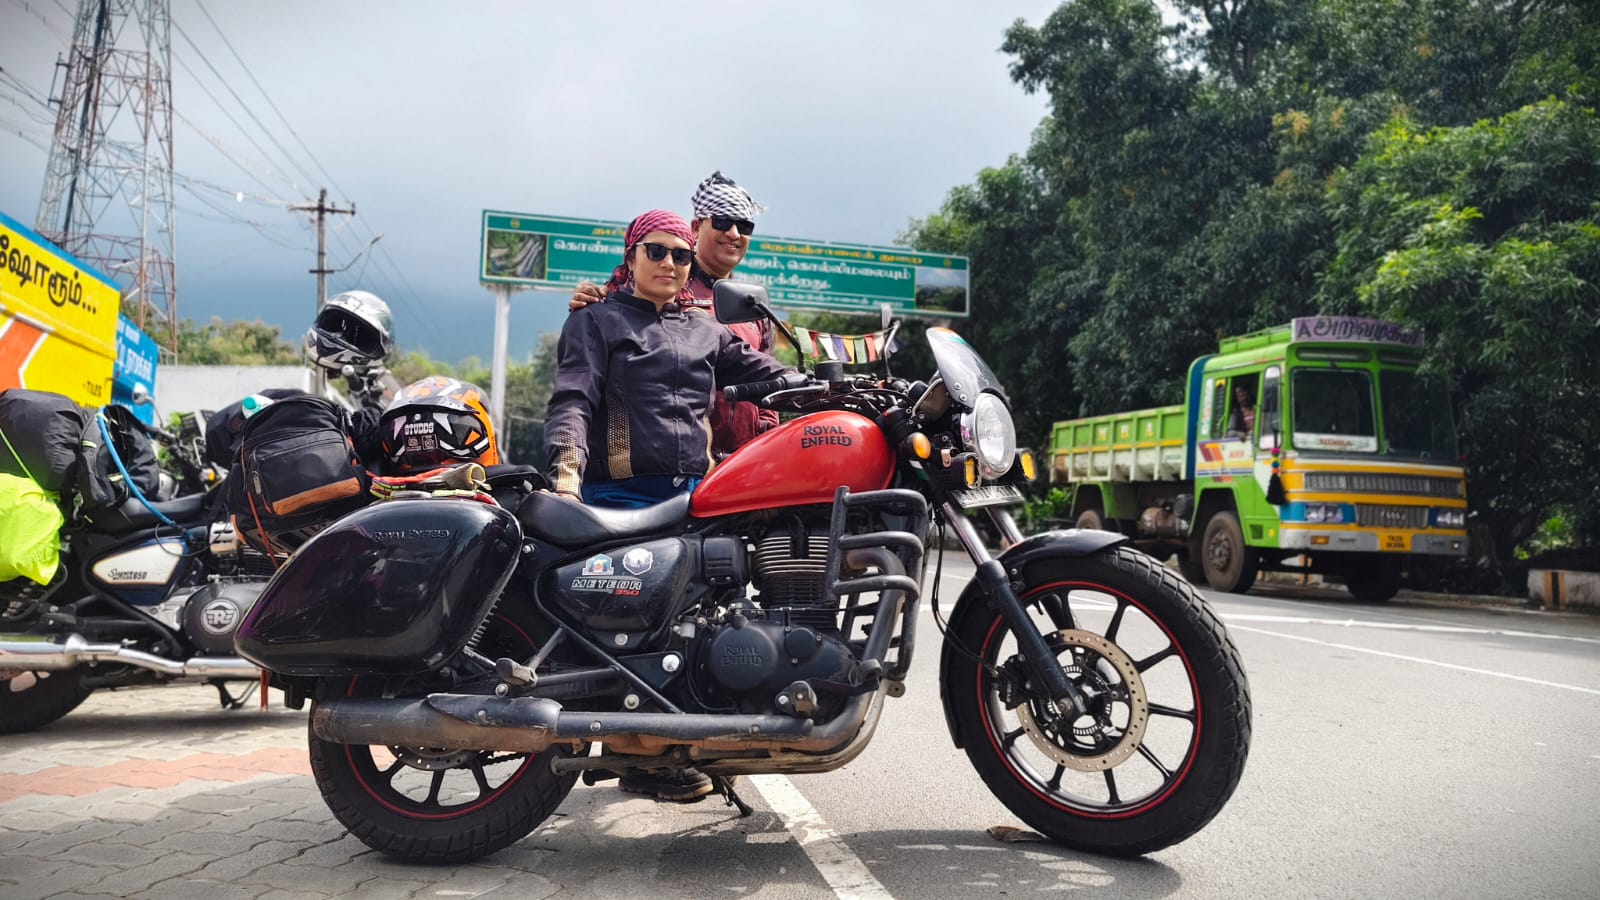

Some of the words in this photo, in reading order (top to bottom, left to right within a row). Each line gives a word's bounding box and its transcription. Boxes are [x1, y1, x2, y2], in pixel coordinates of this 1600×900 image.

[1298, 321, 1311, 338] A
[404, 422, 434, 436] STUDDS
[804, 425, 845, 436] ROYAL
[801, 436, 852, 448] ENFIELD
[571, 579, 643, 590] METEOR
